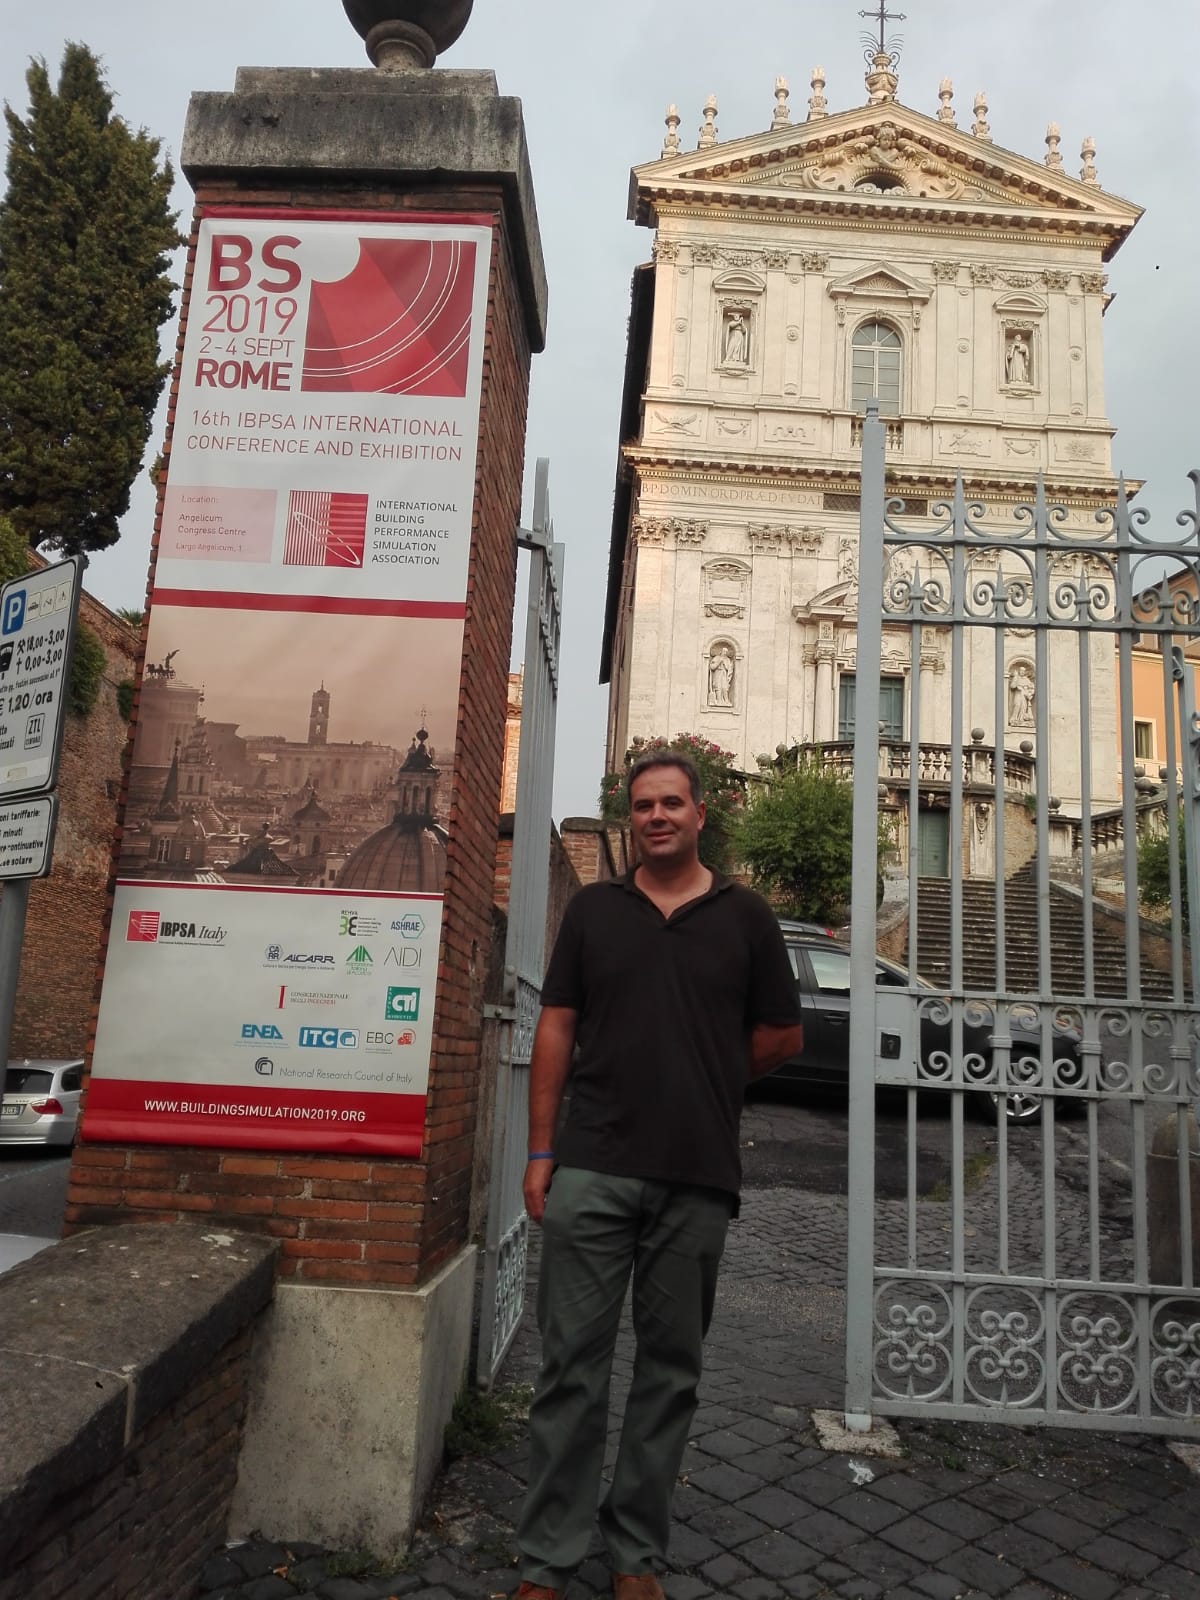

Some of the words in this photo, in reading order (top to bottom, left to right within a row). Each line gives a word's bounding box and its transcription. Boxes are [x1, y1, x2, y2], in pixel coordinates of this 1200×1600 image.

[207, 234, 302, 293] BS
[202, 294, 298, 335] 2019
[243, 337, 296, 357] SEPT
[194, 358, 293, 391] ROME
[192, 409, 231, 427] 16th
[238, 412, 297, 430] IBPSA
[302, 414, 463, 437] INTERNATIONAL
[187, 435, 309, 454] CONFERENCE
[314, 440, 353, 457] AND
[360, 442, 462, 461] EXHIBITION
[375, 500, 458, 513] INTERNATIONAL
[179, 513, 223, 523] Angelicum
[375, 514, 425, 525] BUILDING
[178, 525, 216, 536] Congress
[218, 527, 247, 536] Centre
[374, 527, 450, 539] PERFORMANCE
[372, 540, 437, 552] SIMULATION
[371, 554, 441, 565] ASSOCIATION
[7, 592, 22, 630] P
[28, 718, 41, 735] ZTL
[160, 922, 196, 938] IBPSA
[198, 925, 227, 943] Italy
[390, 921, 420, 932] ASHRAE
[241, 1024, 284, 1040] ENEA
[302, 1029, 336, 1046] ITC
[366, 1031, 394, 1045] EBC
[280, 1067, 314, 1079] National
[317, 1069, 352, 1080] Research
[354, 1069, 384, 1082] Council
[385, 1072, 395, 1083] of
[395, 1073, 413, 1085] Italy
[144, 1099, 366, 1123] WWW.BUILDINGSIMULATION2019.ORG
